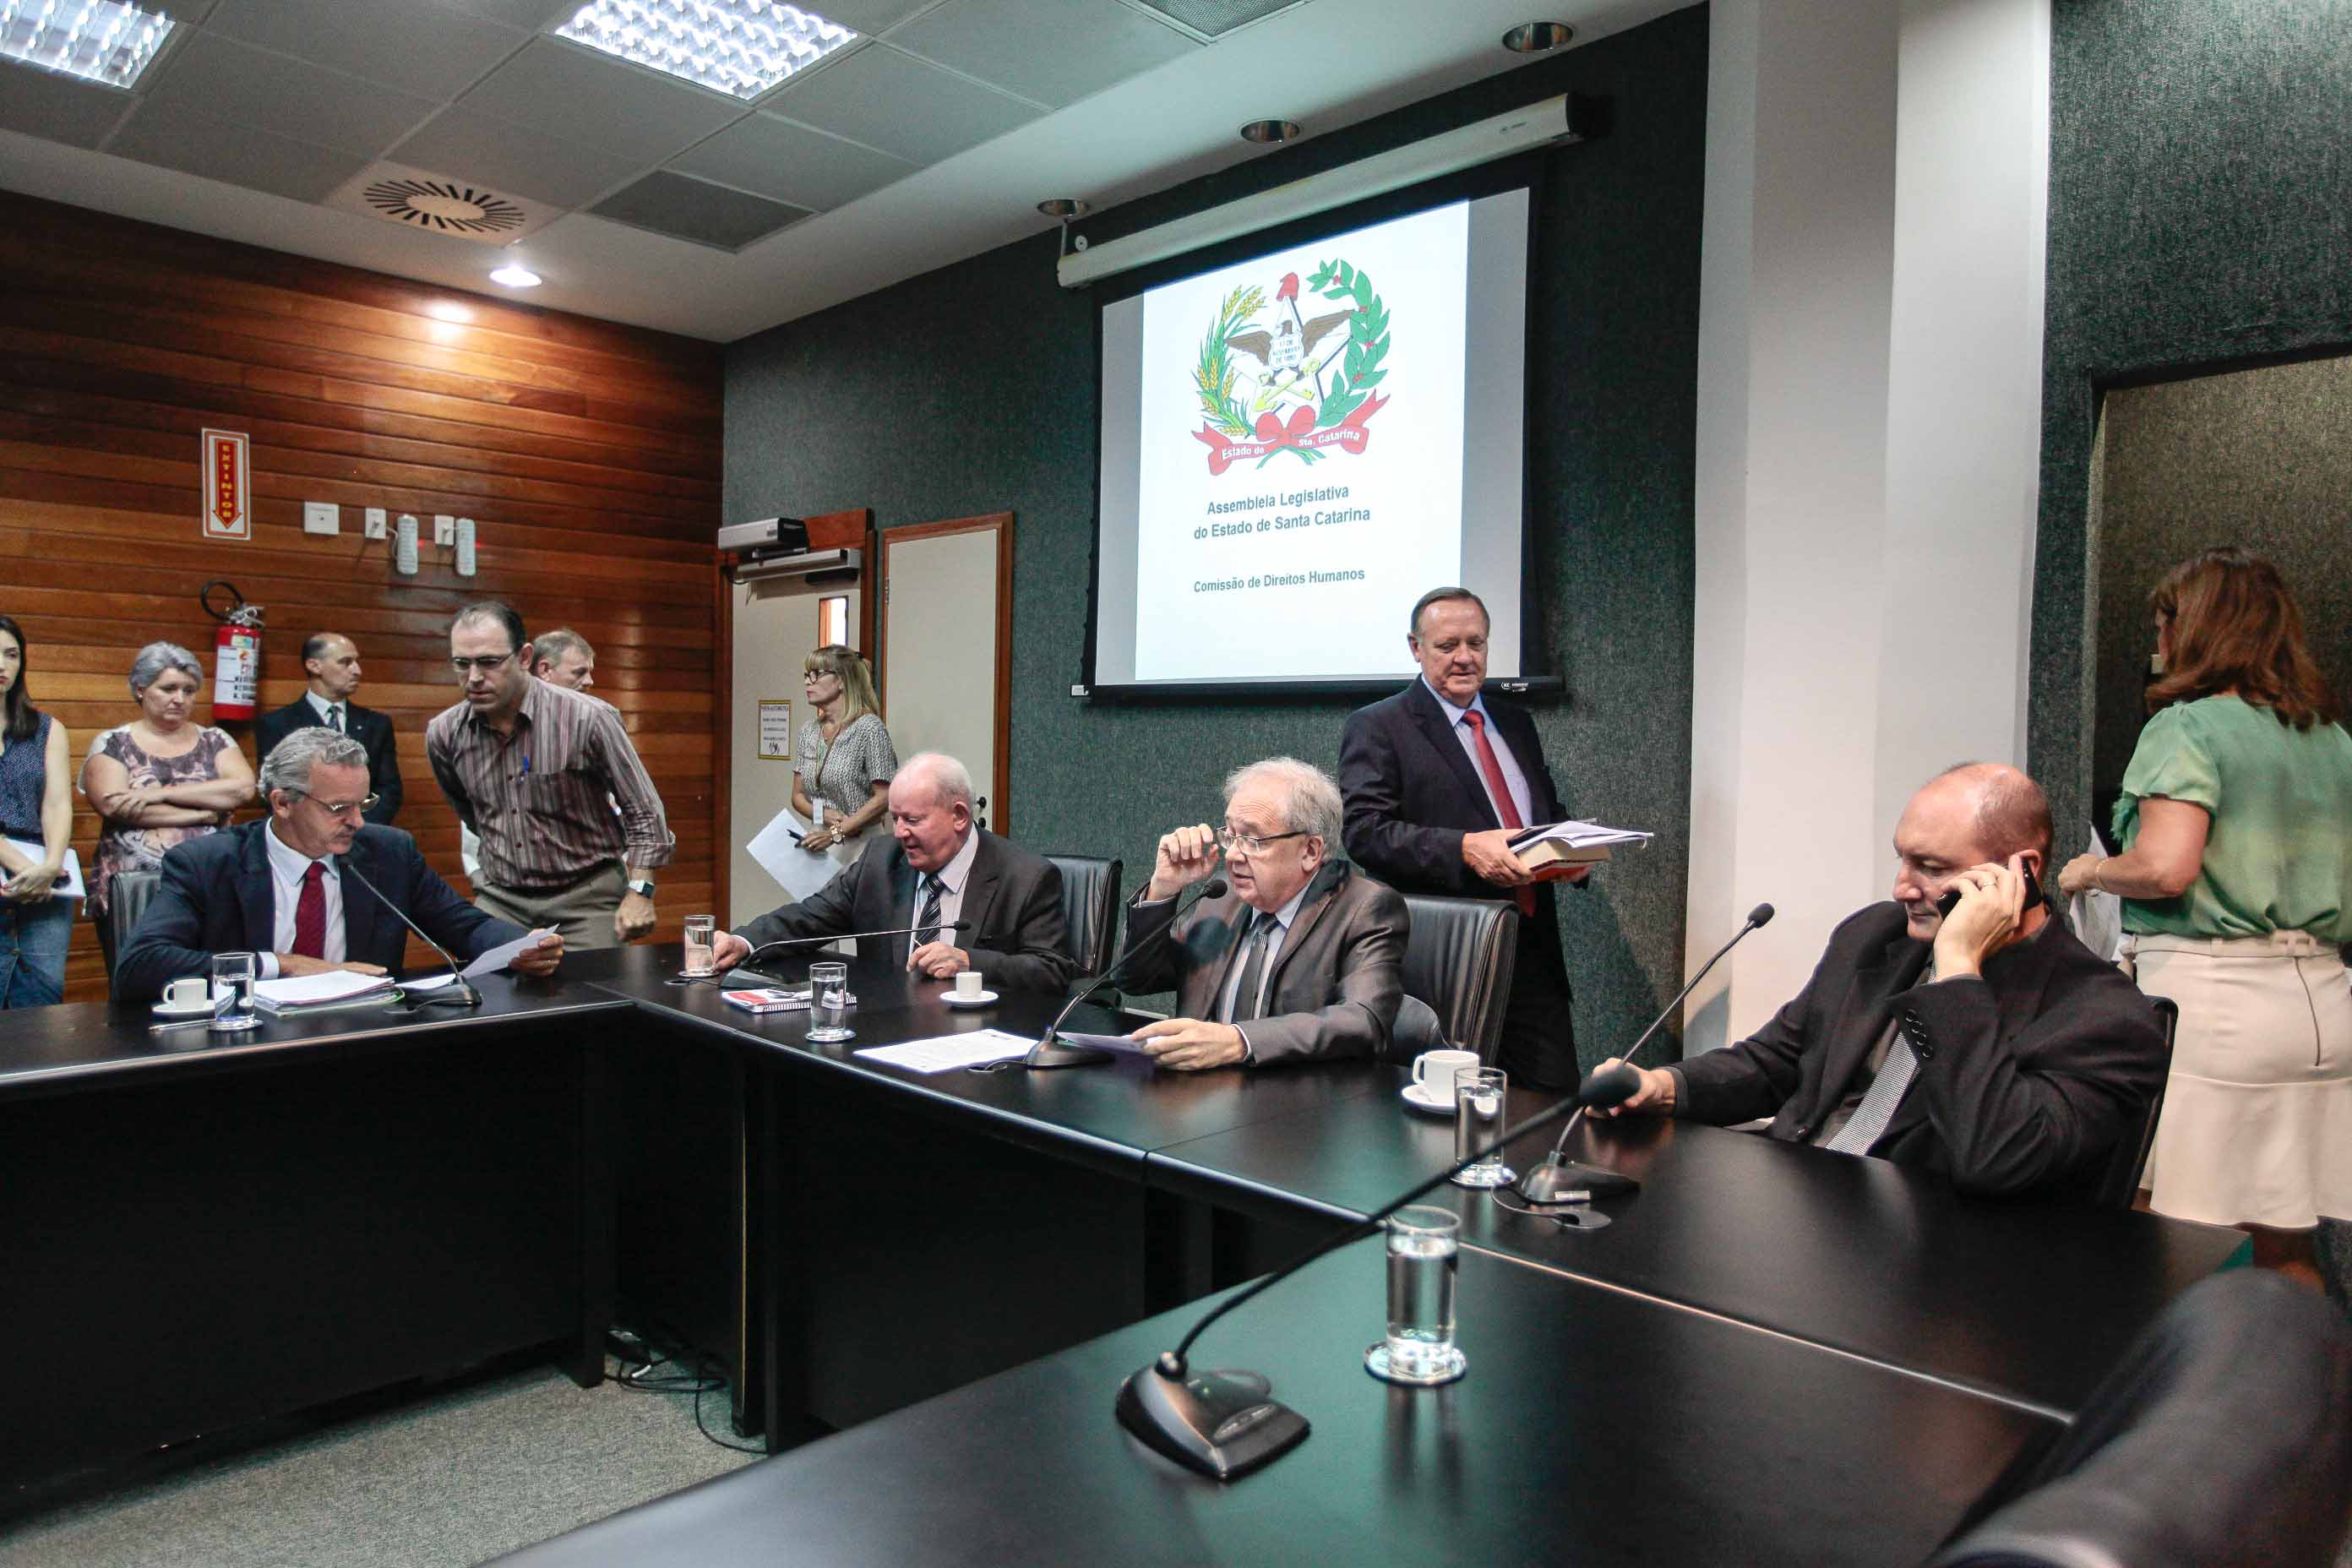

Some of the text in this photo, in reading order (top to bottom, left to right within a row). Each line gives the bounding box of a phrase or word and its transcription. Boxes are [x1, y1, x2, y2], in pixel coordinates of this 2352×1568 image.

[1222, 445, 1252, 460] Estado
[1318, 428, 1361, 444] Catarina
[1207, 486, 1349, 514] Assembleia Legislativa
[1194, 508, 1371, 539] do Estado de Santa Catarina
[1194, 569, 1365, 592] Comissão de Direitos Humanos
